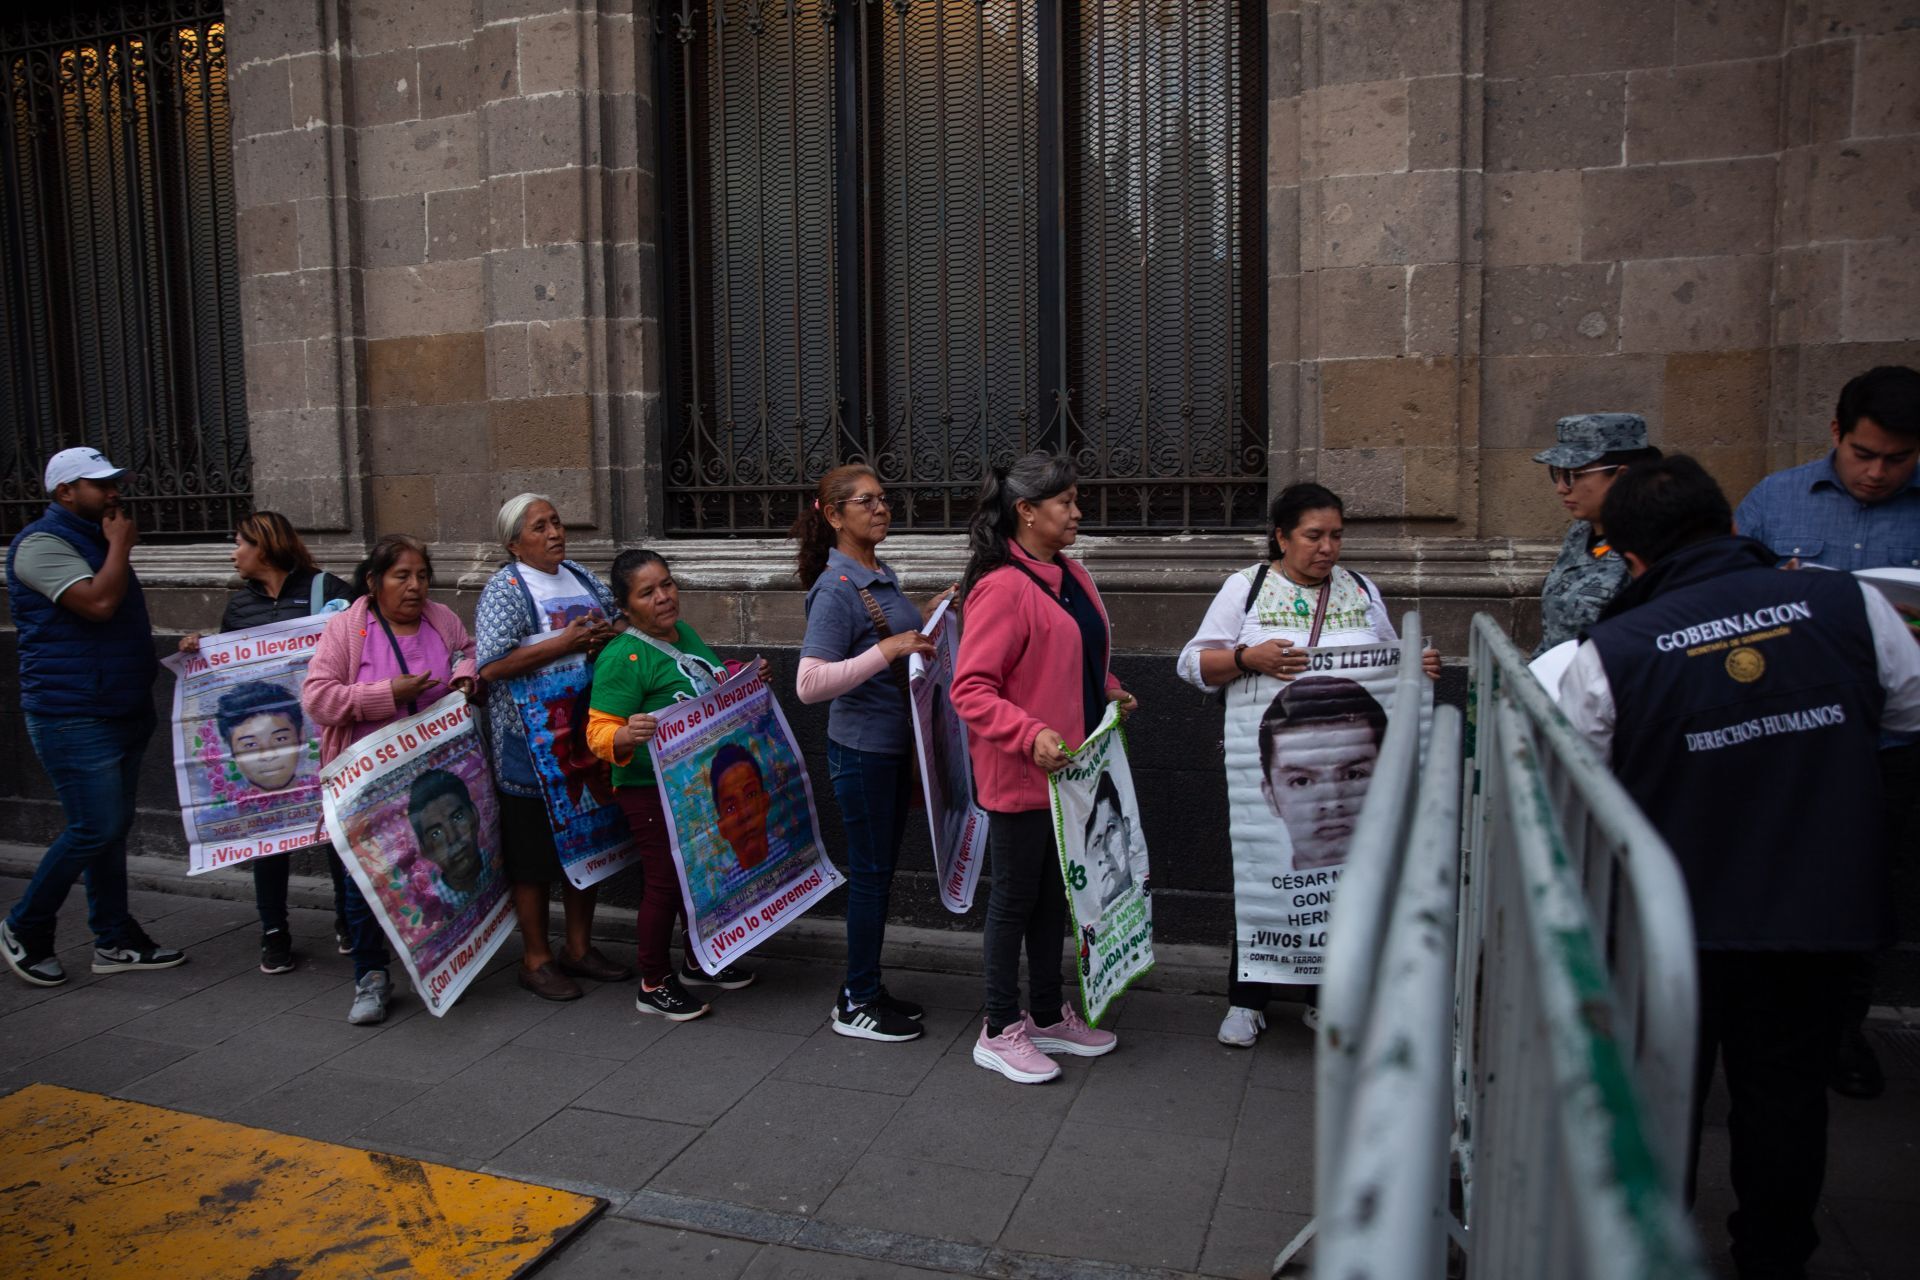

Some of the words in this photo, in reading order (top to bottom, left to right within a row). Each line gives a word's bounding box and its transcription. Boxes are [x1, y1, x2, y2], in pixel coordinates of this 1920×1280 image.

[1656, 601, 1812, 651] GOBERNACION
[210, 652, 230, 665] se
[235, 646, 250, 660] lo
[1340, 647, 1401, 669] LLEVAR
[656, 720, 685, 751] ¡Vivo
[688, 711, 701, 728] se
[703, 702, 714, 718] lo
[714, 676, 764, 711] llevaron!
[1685, 719, 1763, 752] DERECHOS
[1761, 704, 1846, 735] HUMANOS
[331, 756, 374, 799] ¡Vivo
[376, 743, 399, 764] se
[397, 734, 418, 752] lo
[416, 703, 471, 741] llevaro
[212, 846, 253, 867] ¡Vivo
[258, 841, 273, 855] lo
[1272, 873, 1328, 889] CÉSAR
[1293, 890, 1334, 907] GON
[711, 926, 745, 958] ¡Vivo
[744, 915, 759, 931] lo
[761, 869, 822, 922] queremos!
[1250, 931, 1302, 948] ¡VIVOS
[1309, 932, 1328, 947] LO
[429, 969, 451, 999] ¡Con
[449, 944, 474, 975] VIDA
[474, 937, 482, 953] lo
[1250, 954, 1278, 962] CONTRA
[1293, 956, 1325, 964] TERROR
